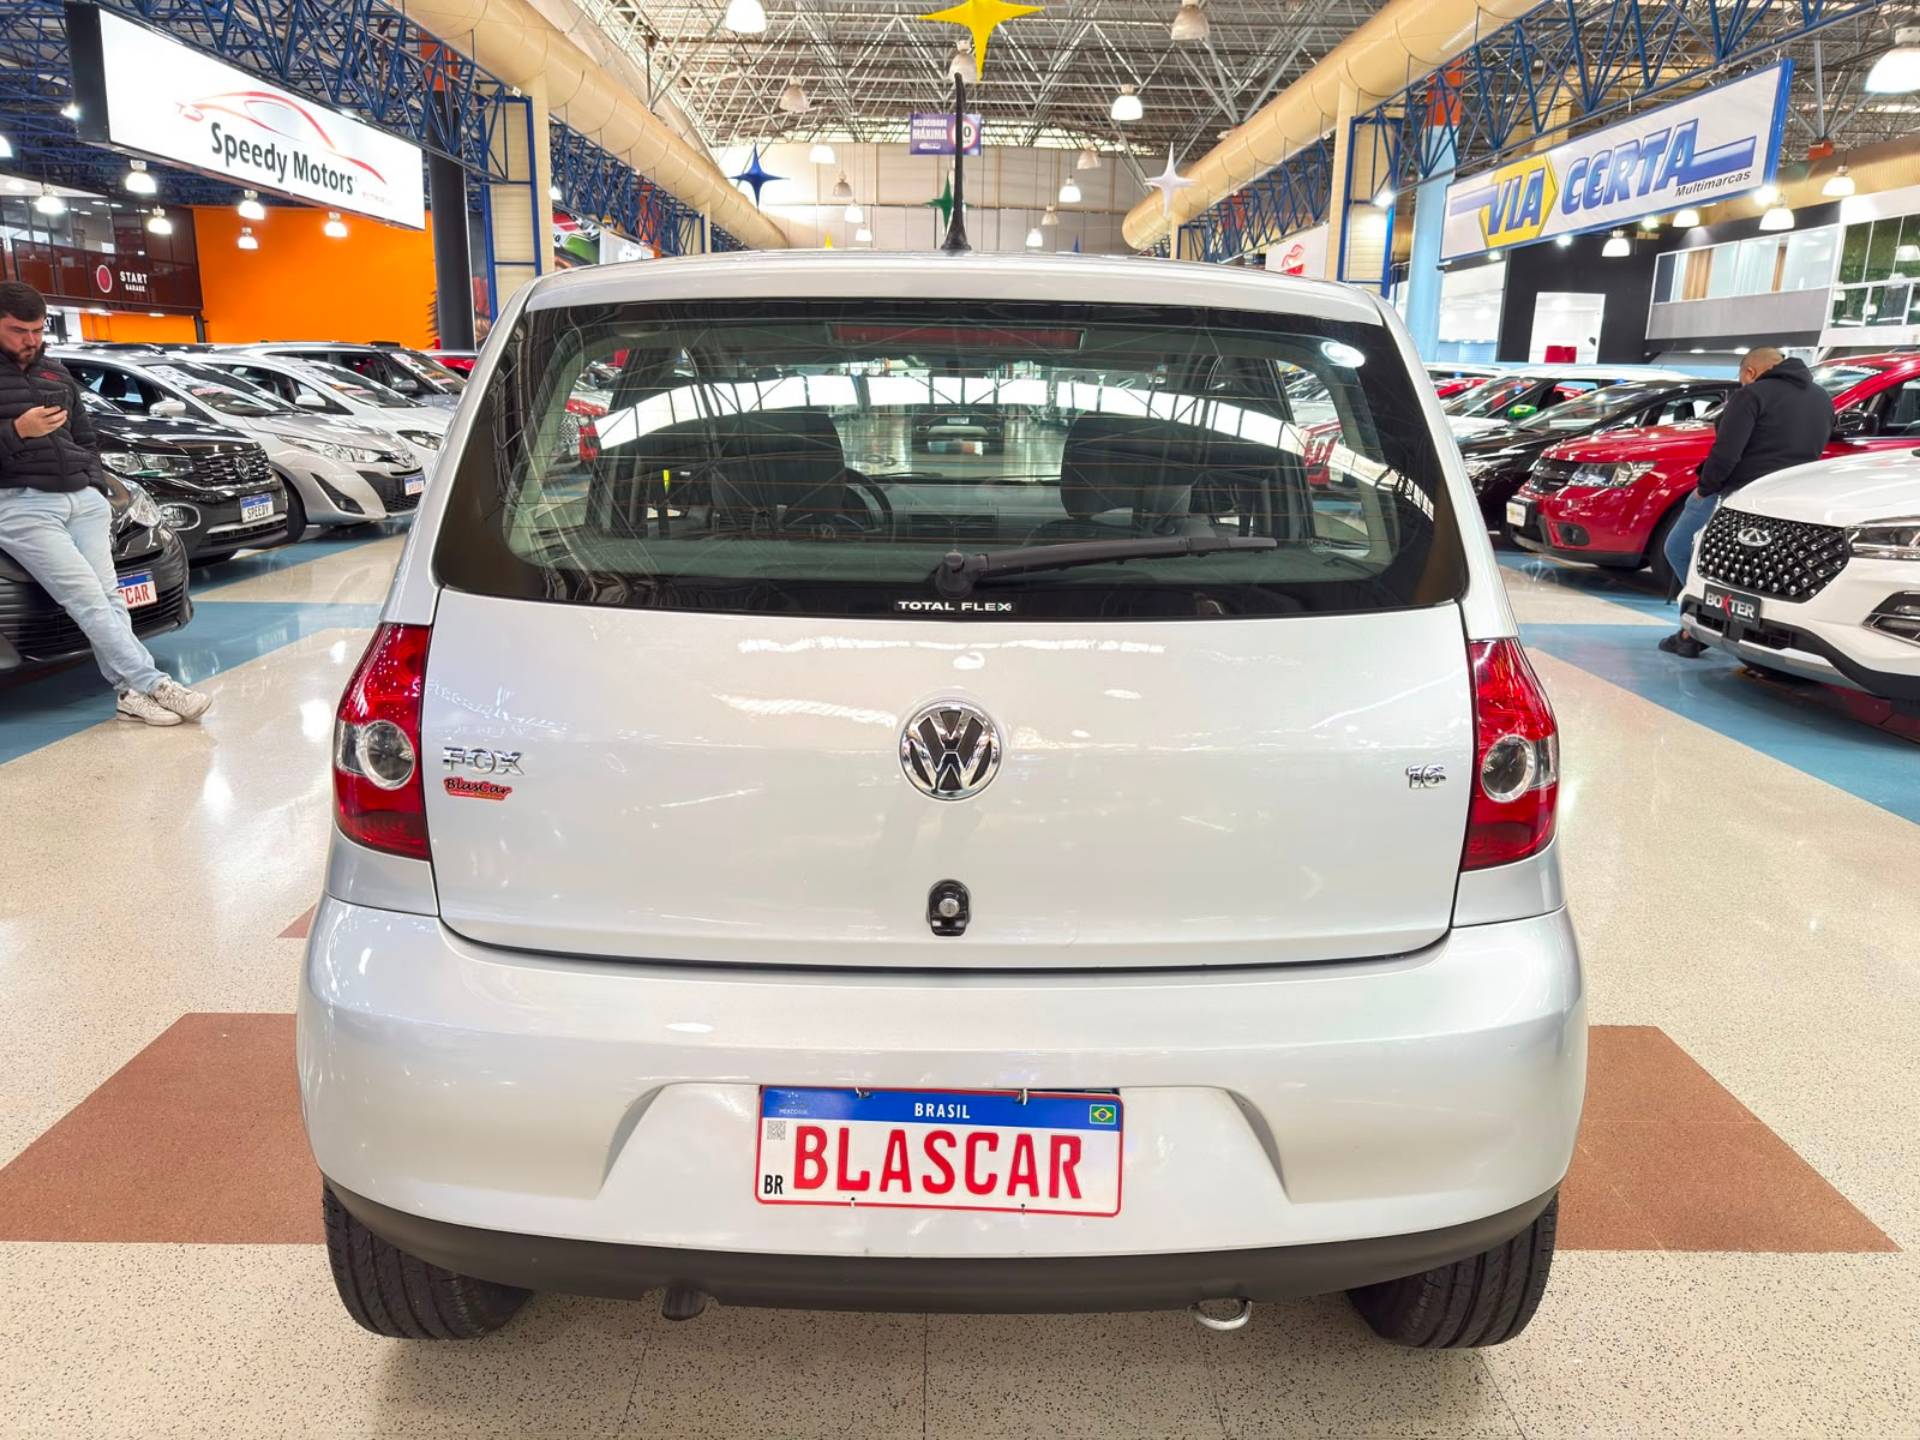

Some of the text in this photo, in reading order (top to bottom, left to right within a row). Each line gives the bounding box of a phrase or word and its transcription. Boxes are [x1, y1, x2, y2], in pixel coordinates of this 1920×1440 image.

[211, 122, 353, 195] Speedy Motors
[1484, 118, 1699, 235] VIA CERTA
[1674, 170, 1751, 197] Multimarcas
[120, 271, 148, 284] START
[247, 504, 270, 519] SPEEDY
[118, 583, 150, 604] CAR
[898, 601, 1013, 612] TOTAL FLEX
[1705, 592, 1754, 618] BOXTER
[442, 747, 525, 775] FOX
[446, 777, 512, 794] BlasCar
[914, 1102, 970, 1119] BRASIL
[793, 1126, 1081, 1199] BLASCAR
[764, 1174, 783, 1194] BR
